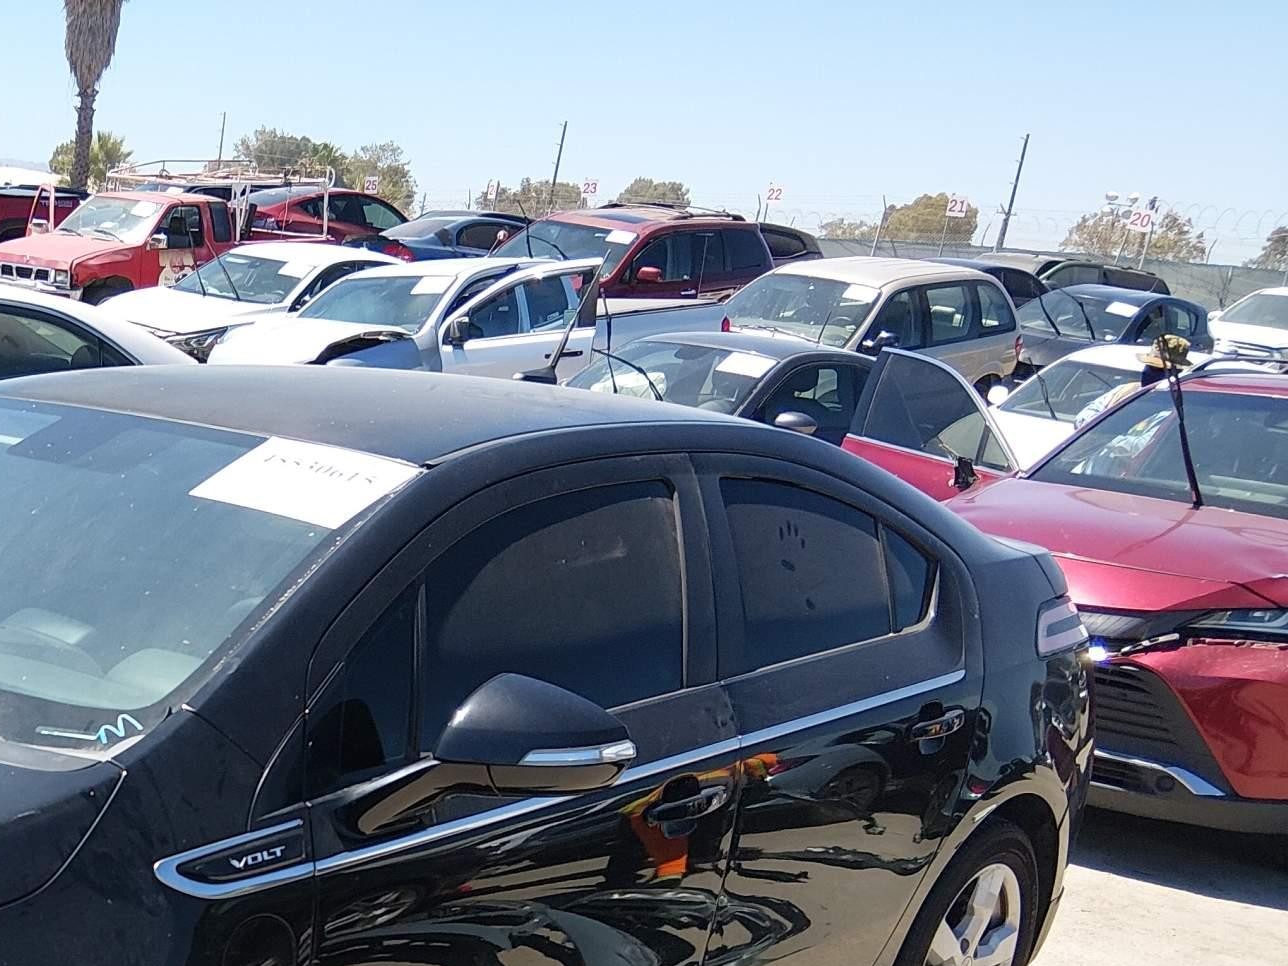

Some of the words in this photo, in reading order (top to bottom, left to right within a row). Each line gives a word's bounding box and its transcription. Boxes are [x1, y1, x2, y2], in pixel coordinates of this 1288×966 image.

[365, 179, 378, 191] 25
[583, 182, 598, 194] 23
[767, 188, 783, 201] 22
[948, 199, 965, 213] 21
[1129, 211, 1152, 228] 20
[229, 845, 286, 869] VOLT
